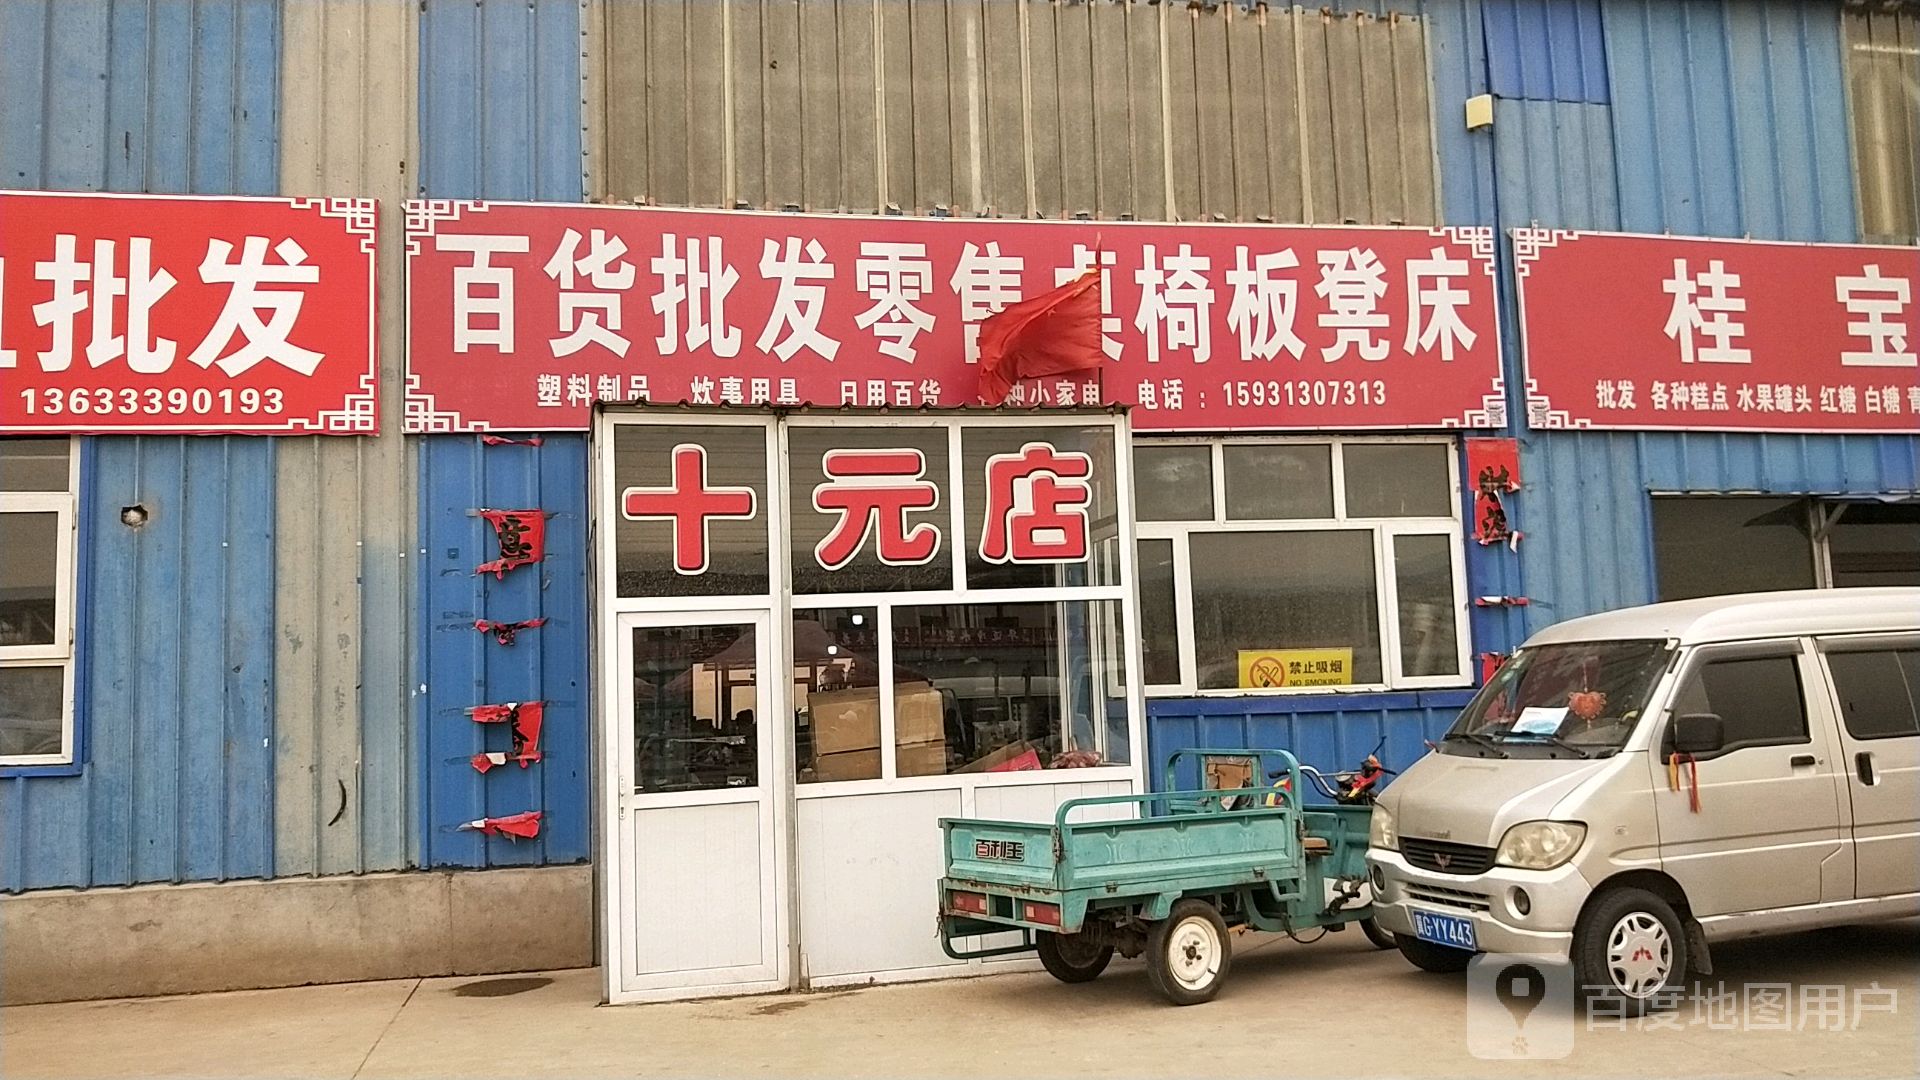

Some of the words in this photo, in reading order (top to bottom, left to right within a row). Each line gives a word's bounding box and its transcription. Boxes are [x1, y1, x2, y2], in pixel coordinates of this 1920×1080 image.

[0, 234, 325, 378] 批发
[20, 388, 284, 415] 13633390193
[537, 374, 650, 407] 塑料制品
[690, 376, 799, 405] 炊事用具
[840, 379, 942, 406] 日用百货
[977, 379, 1100, 407] 种小家电
[1596, 380, 1636, 409] 批发
[1651, 380, 1729, 411] 各种糕点
[1736, 383, 1812, 413] 水果罐头
[1820, 385, 1857, 414] 红糖
[1865, 385, 1900, 414] 白糖
[622, 441, 1092, 575] 十元店
[1289, 660, 1342, 674] 禁止吸烟
[1304, 678, 1342, 686] SMOKING
[976, 839, 1024, 861] 百利王
